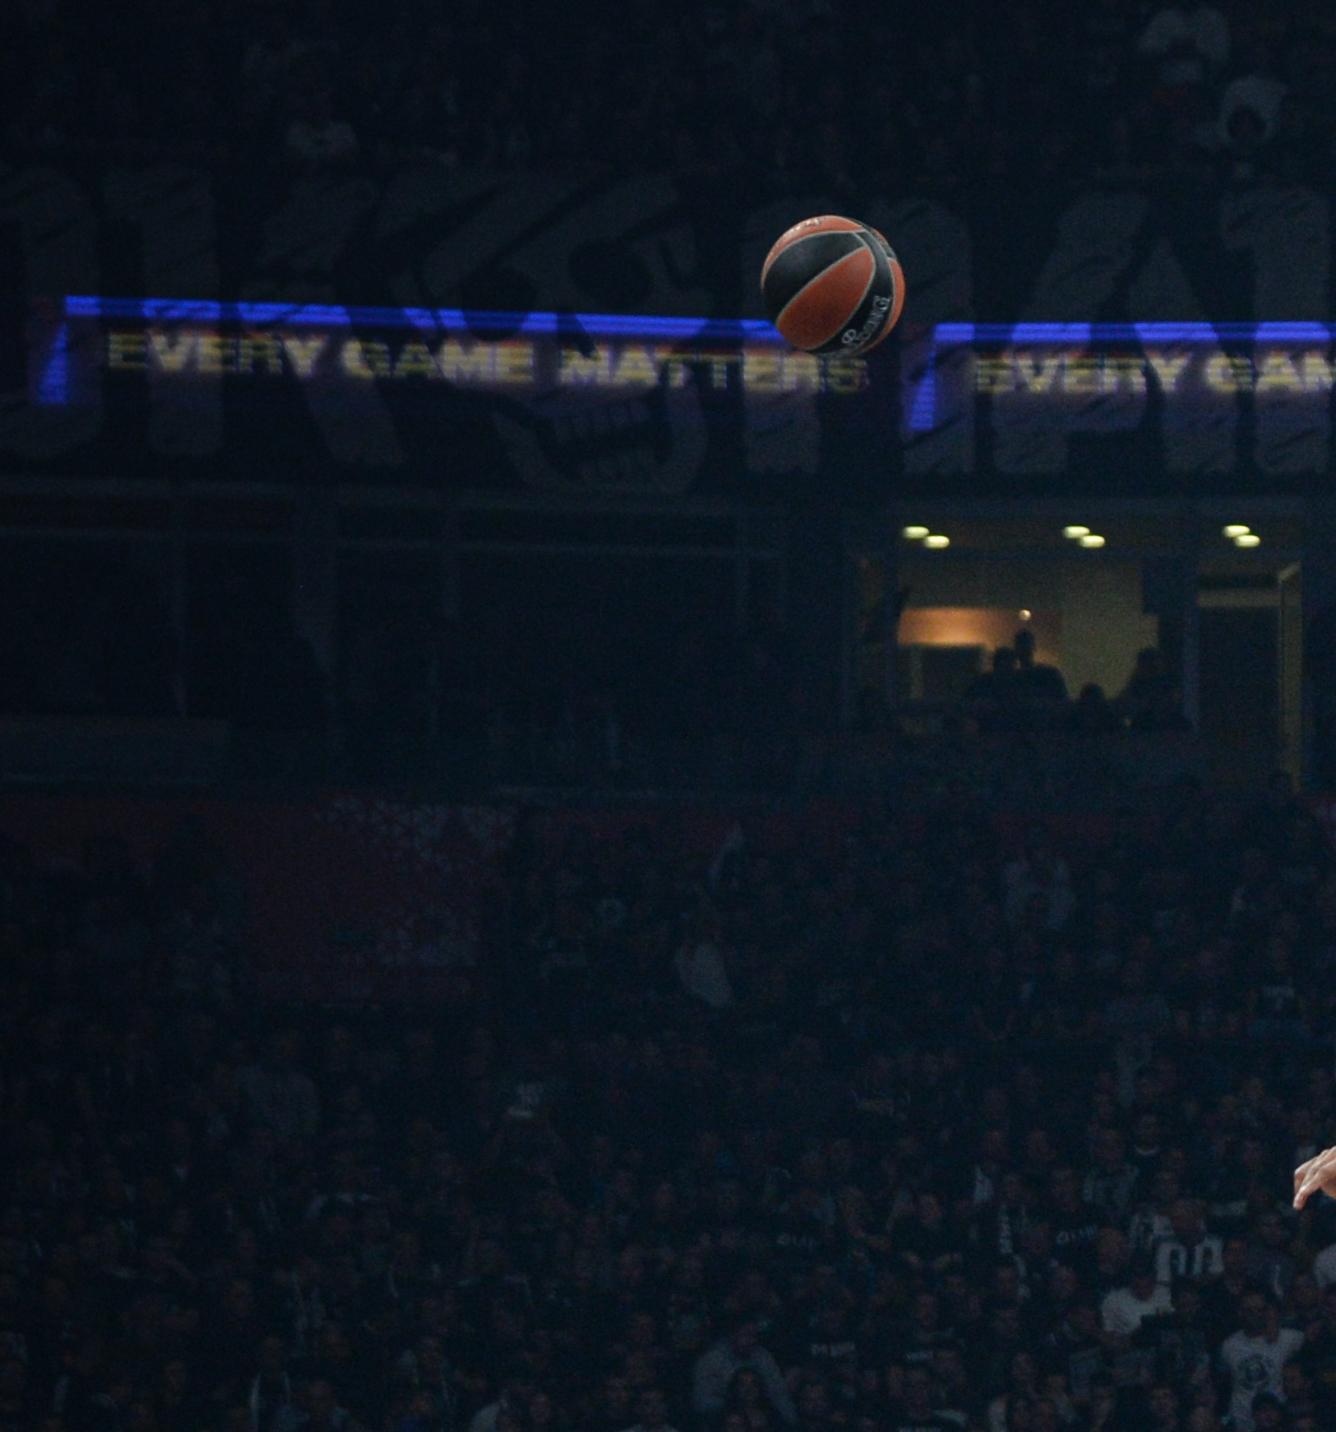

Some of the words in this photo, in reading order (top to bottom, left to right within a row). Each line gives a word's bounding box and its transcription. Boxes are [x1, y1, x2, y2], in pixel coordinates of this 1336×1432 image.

[107, 332, 326, 379] EVERY
[341, 334, 534, 384] GAME
[557, 342, 871, 395] MATTERS
[975, 352, 1187, 394] EVERY
